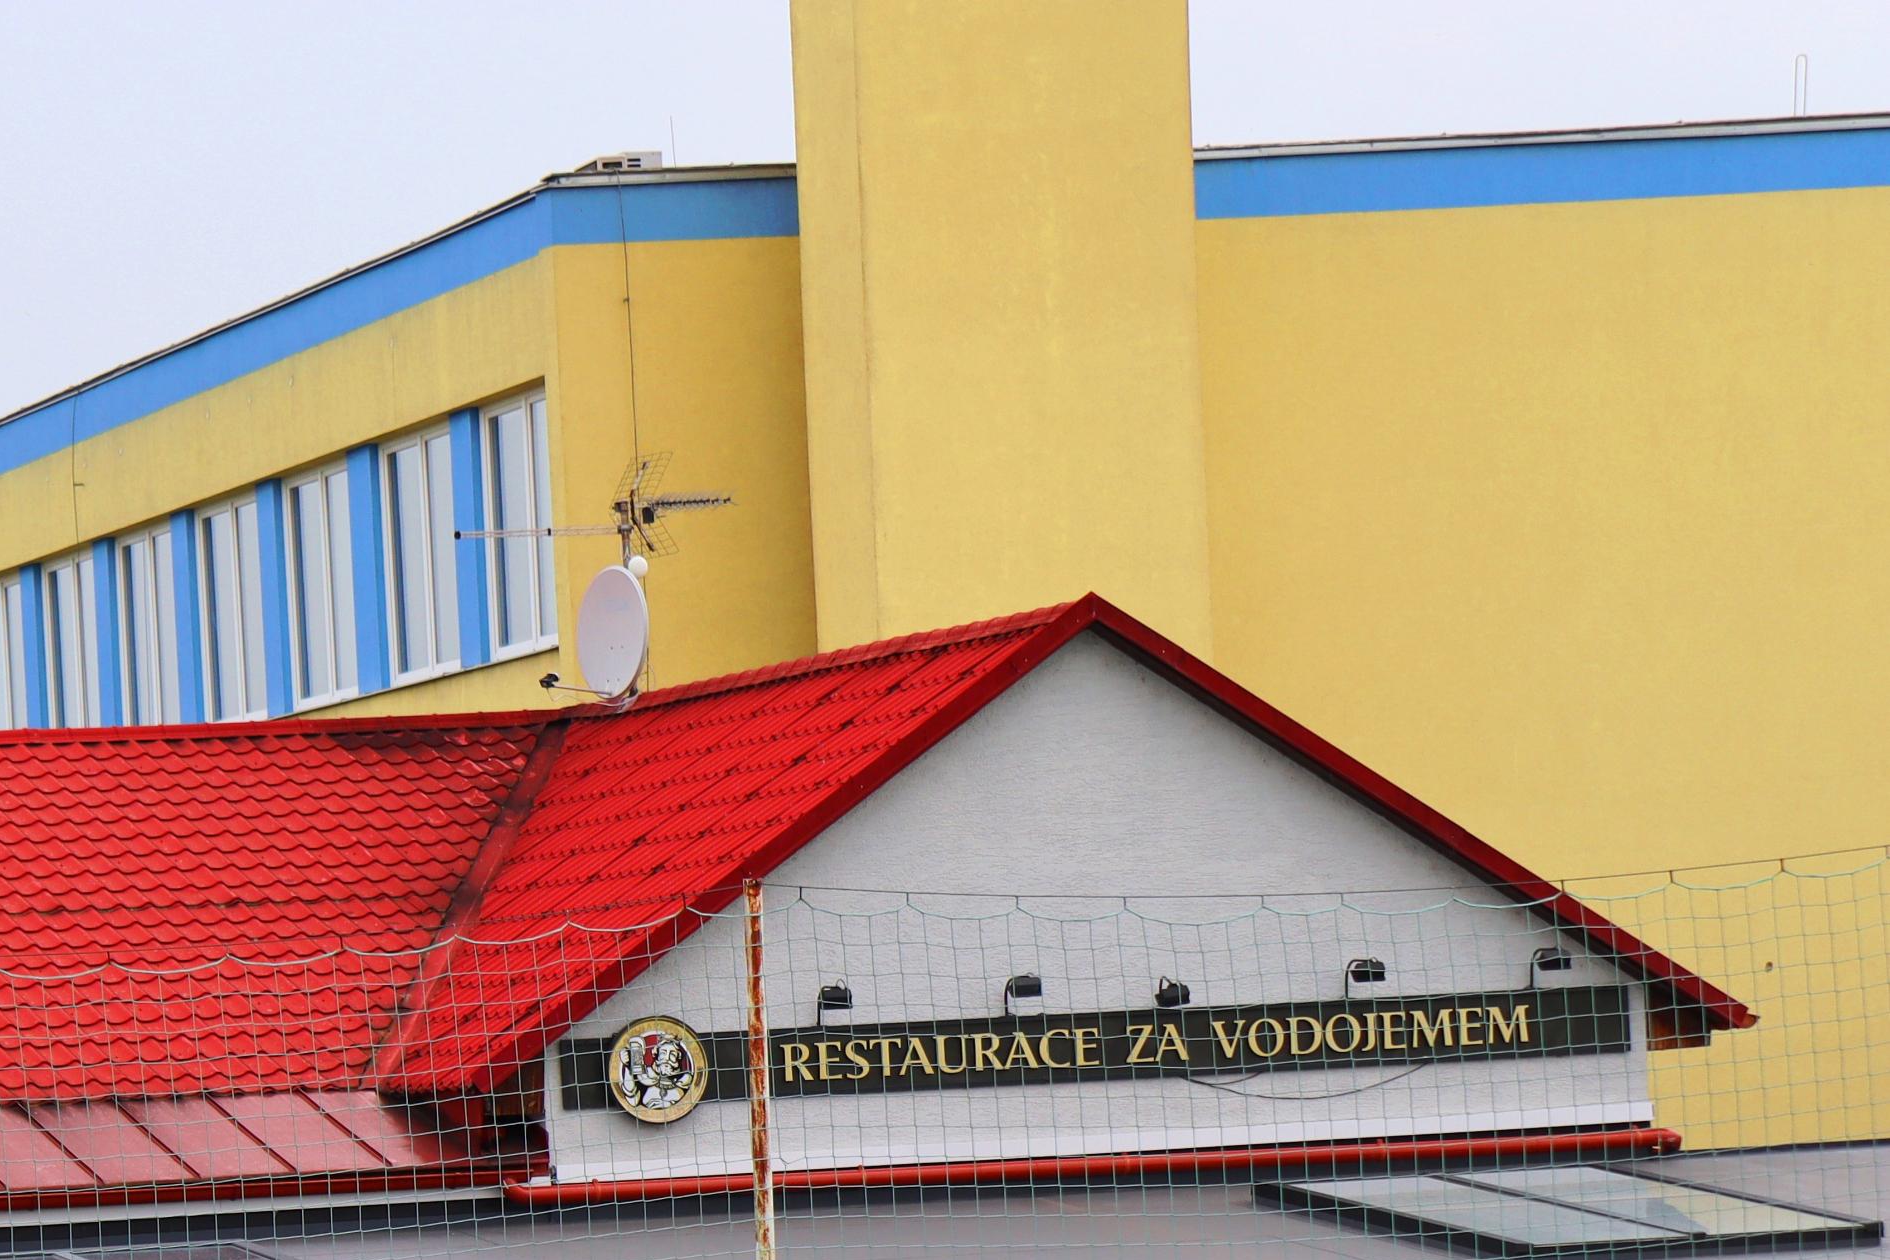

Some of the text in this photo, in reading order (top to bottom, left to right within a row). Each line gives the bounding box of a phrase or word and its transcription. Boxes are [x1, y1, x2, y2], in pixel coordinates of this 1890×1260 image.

[779, 1004, 1530, 1082] RESTAURACE ZA VODOJEMEM
